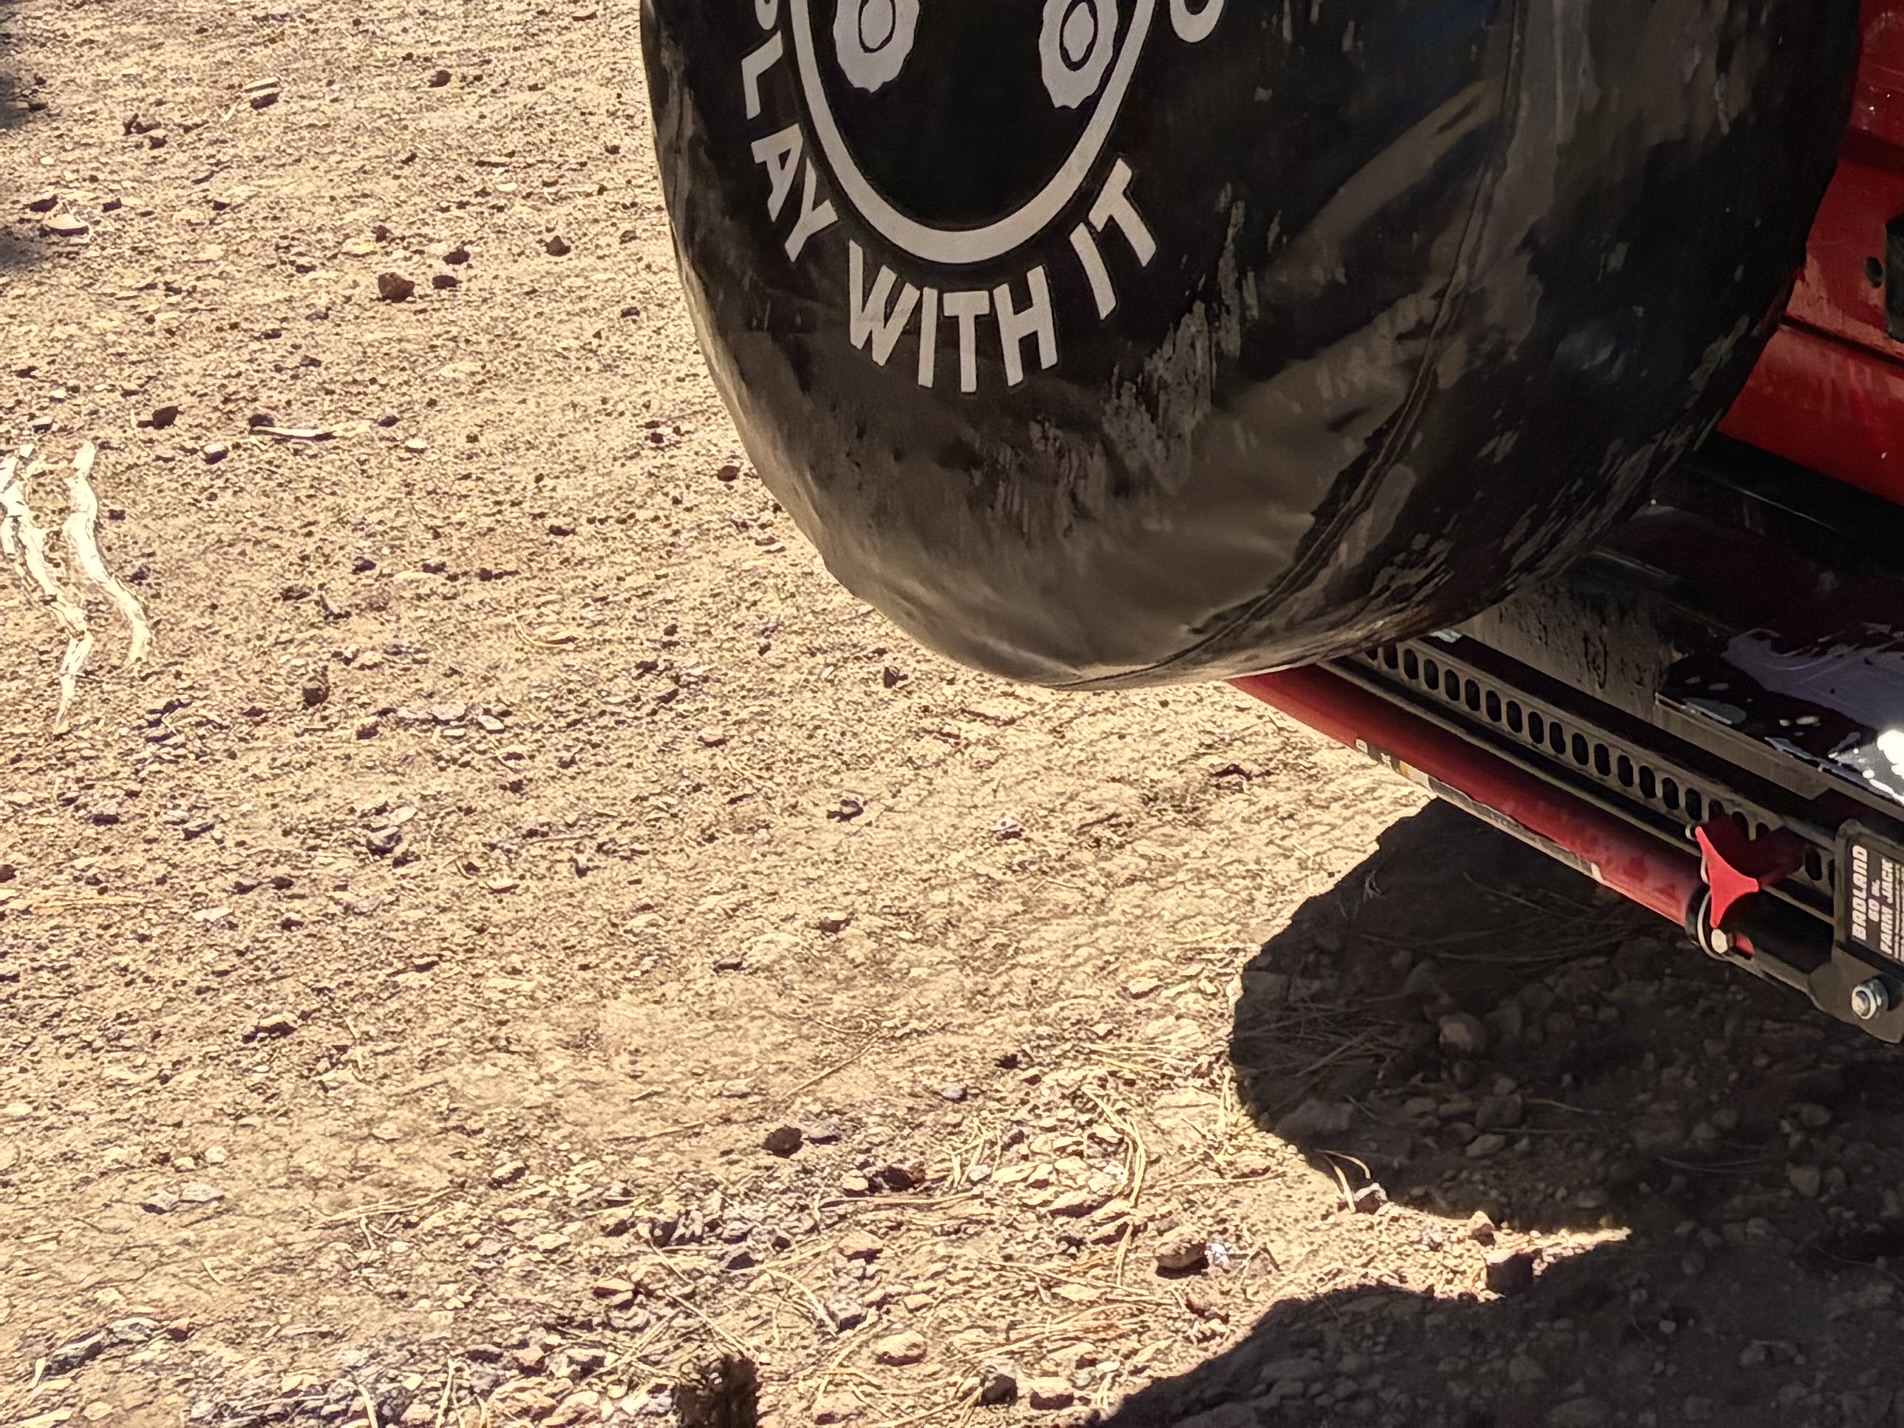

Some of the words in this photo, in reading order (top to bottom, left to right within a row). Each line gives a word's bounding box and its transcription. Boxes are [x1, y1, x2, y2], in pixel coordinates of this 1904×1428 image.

[848, 238, 1058, 394] WITH
[1069, 157, 1157, 320] IT
[1851, 844, 1868, 941] BADLAND
[1881, 858, 1893, 904] JACK
[1880, 905, 1893, 955] FARM
